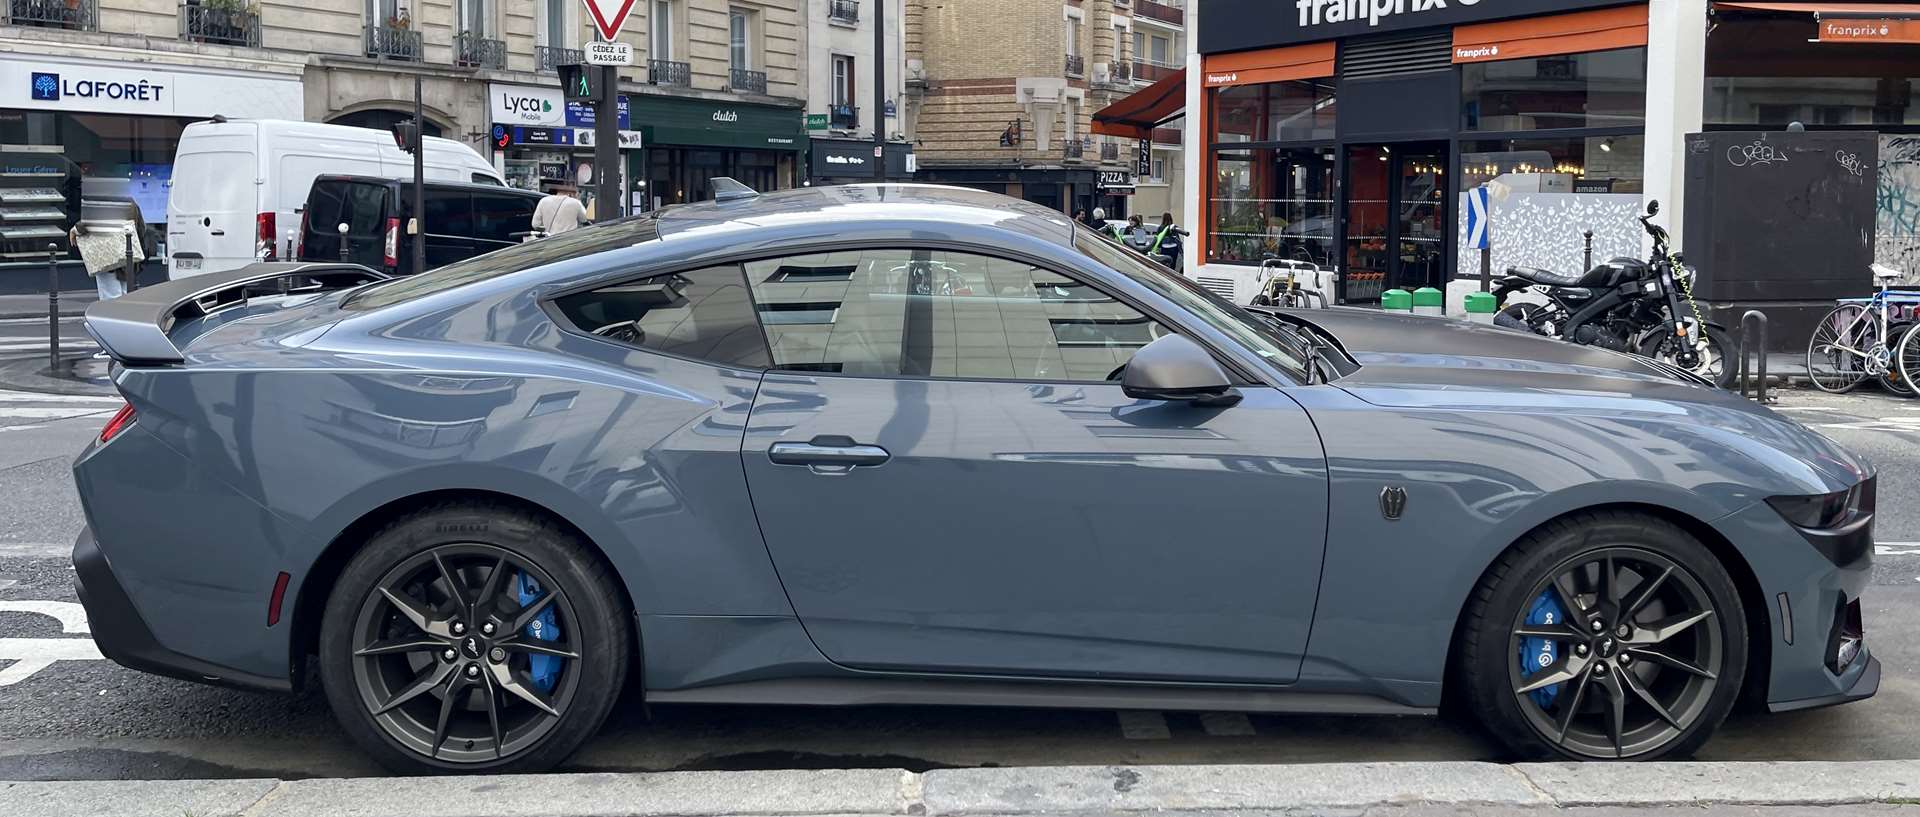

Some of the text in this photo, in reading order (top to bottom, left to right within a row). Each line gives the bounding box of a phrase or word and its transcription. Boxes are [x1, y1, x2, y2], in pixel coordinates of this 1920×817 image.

[1827, 24, 1876, 36] franprix
[593, 45, 614, 54] CÉDEZ
[1456, 46, 1490, 58] franprix
[594, 55, 626, 63] PASSAGE
[503, 93, 541, 114] Lyca
[521, 111, 541, 121] Mobile
[712, 110, 738, 122] clutch
[1100, 172, 1124, 183] PIZZA
[1576, 185, 1608, 193] amazon
[1542, 613, 1553, 651] brbo
